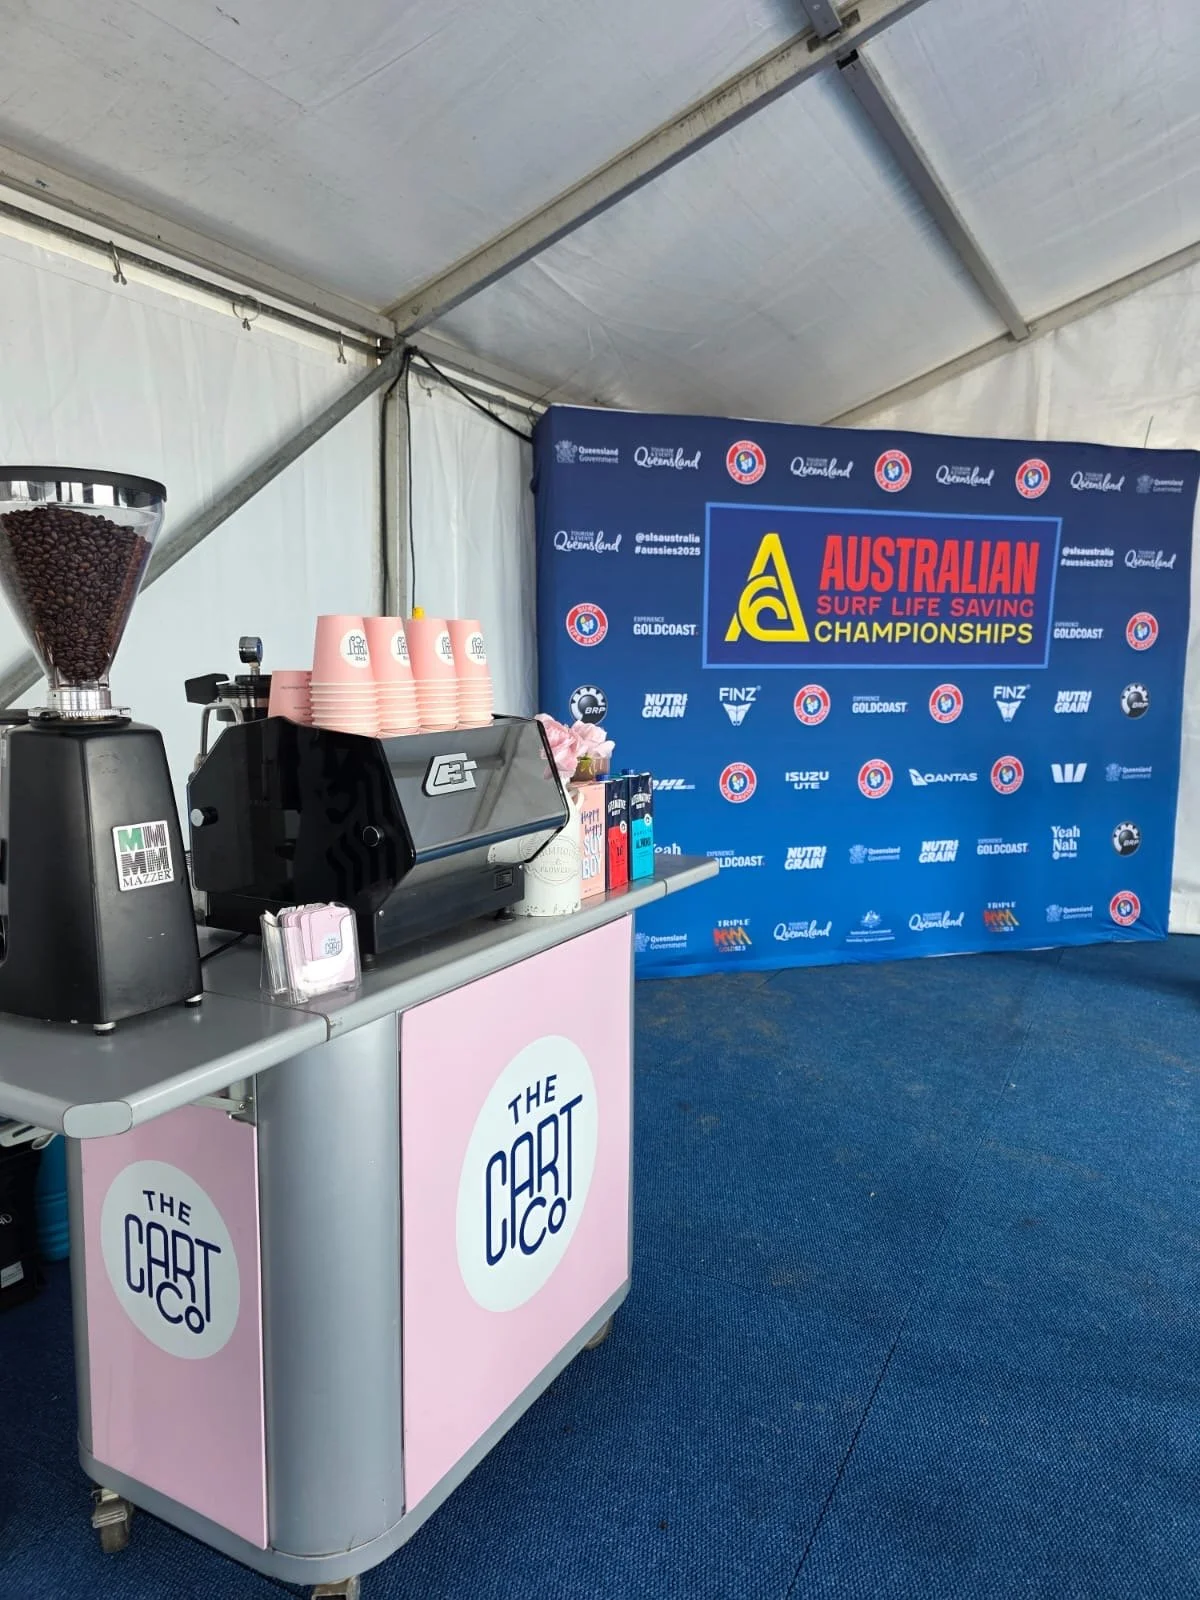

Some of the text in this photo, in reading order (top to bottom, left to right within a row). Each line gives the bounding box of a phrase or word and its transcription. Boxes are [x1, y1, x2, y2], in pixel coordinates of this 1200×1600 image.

[578, 446, 618, 456] Queensland
[578, 455, 618, 464] Government
[634, 446, 702, 470] Queensland
[790, 456, 854, 478] Queensland
[936, 464, 995, 486] Queensland
[1070, 471, 1126, 492] Queensland
[554, 530, 622, 554] Queensland
[635, 532, 700, 543] @slsaustralia
[634, 546, 701, 556] #aussies2025
[1062, 546, 1114, 556] @slsaustralia
[820, 535, 1040, 594] AUSTRALIAN
[1060, 558, 1114, 568] #aussies2025
[1124, 549, 1176, 570] Queensland
[816, 596, 1034, 618] SURF LIFE SAVING
[814, 620, 1033, 644] CHAMPIONSHIPS
[719, 687, 756, 702] FINZ
[993, 686, 1026, 700] FINZ
[1058, 690, 1092, 702] NUTRI
[644, 694, 688, 706] NUTRI
[642, 706, 686, 718] GRAIN
[1054, 702, 1090, 714] GRAIN
[786, 771, 830, 782] ISUZU
[924, 773, 978, 782] QANTAS
[794, 782, 820, 790] UTE
[1051, 825, 1080, 838] Yeah
[653, 843, 682, 856] eah
[922, 840, 959, 852] NUTRI
[1053, 838, 1078, 852] Nah
[787, 846, 827, 858] NUTRI
[918, 852, 956, 864] GRAIN
[784, 858, 824, 870] GRAIN
[122, 869, 172, 888] MAZZER
[717, 918, 750, 927] TRIPLE
[908, 910, 964, 931] Queensland
[774, 920, 832, 941] Queensland
[650, 934, 688, 942] Queensland
[650, 942, 687, 950] Government
[508, 1074, 557, 1125] THE
[486, 1094, 583, 1266] CART
[142, 1190, 192, 1226] THE
[124, 1214, 222, 1322] CART
